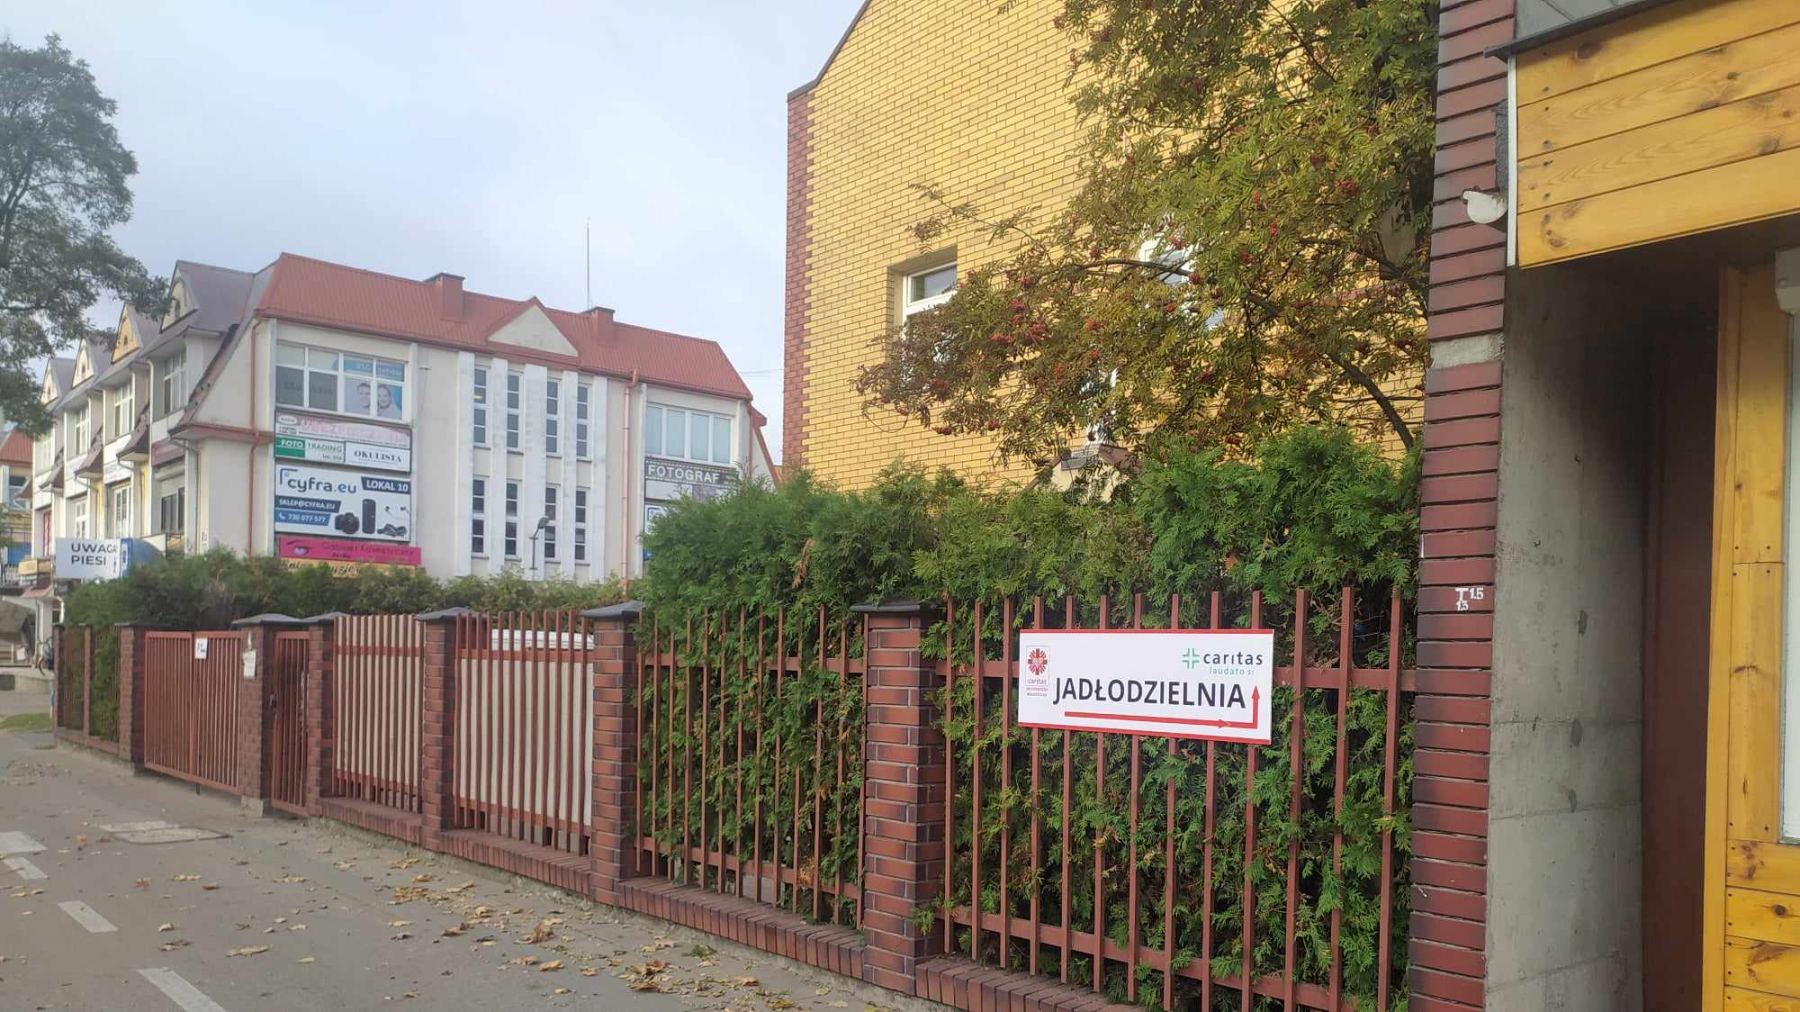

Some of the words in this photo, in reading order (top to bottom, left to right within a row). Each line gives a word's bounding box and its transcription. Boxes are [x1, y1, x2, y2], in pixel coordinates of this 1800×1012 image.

[281, 439, 304, 449] FOTO
[307, 442, 342, 453] TRADING
[354, 449, 402, 463] OKULISTA
[648, 464, 720, 484] FOTOGRAF
[287, 477, 357, 494] cyfra.eu
[366, 480, 395, 490] LOKAL
[397, 483, 409, 492] 10
[71, 555, 106, 566] PIESI
[1455, 587, 1469, 601] T
[1203, 651, 1263, 666] caritas
[1052, 677, 1247, 709] JADŁODZIELNIA
